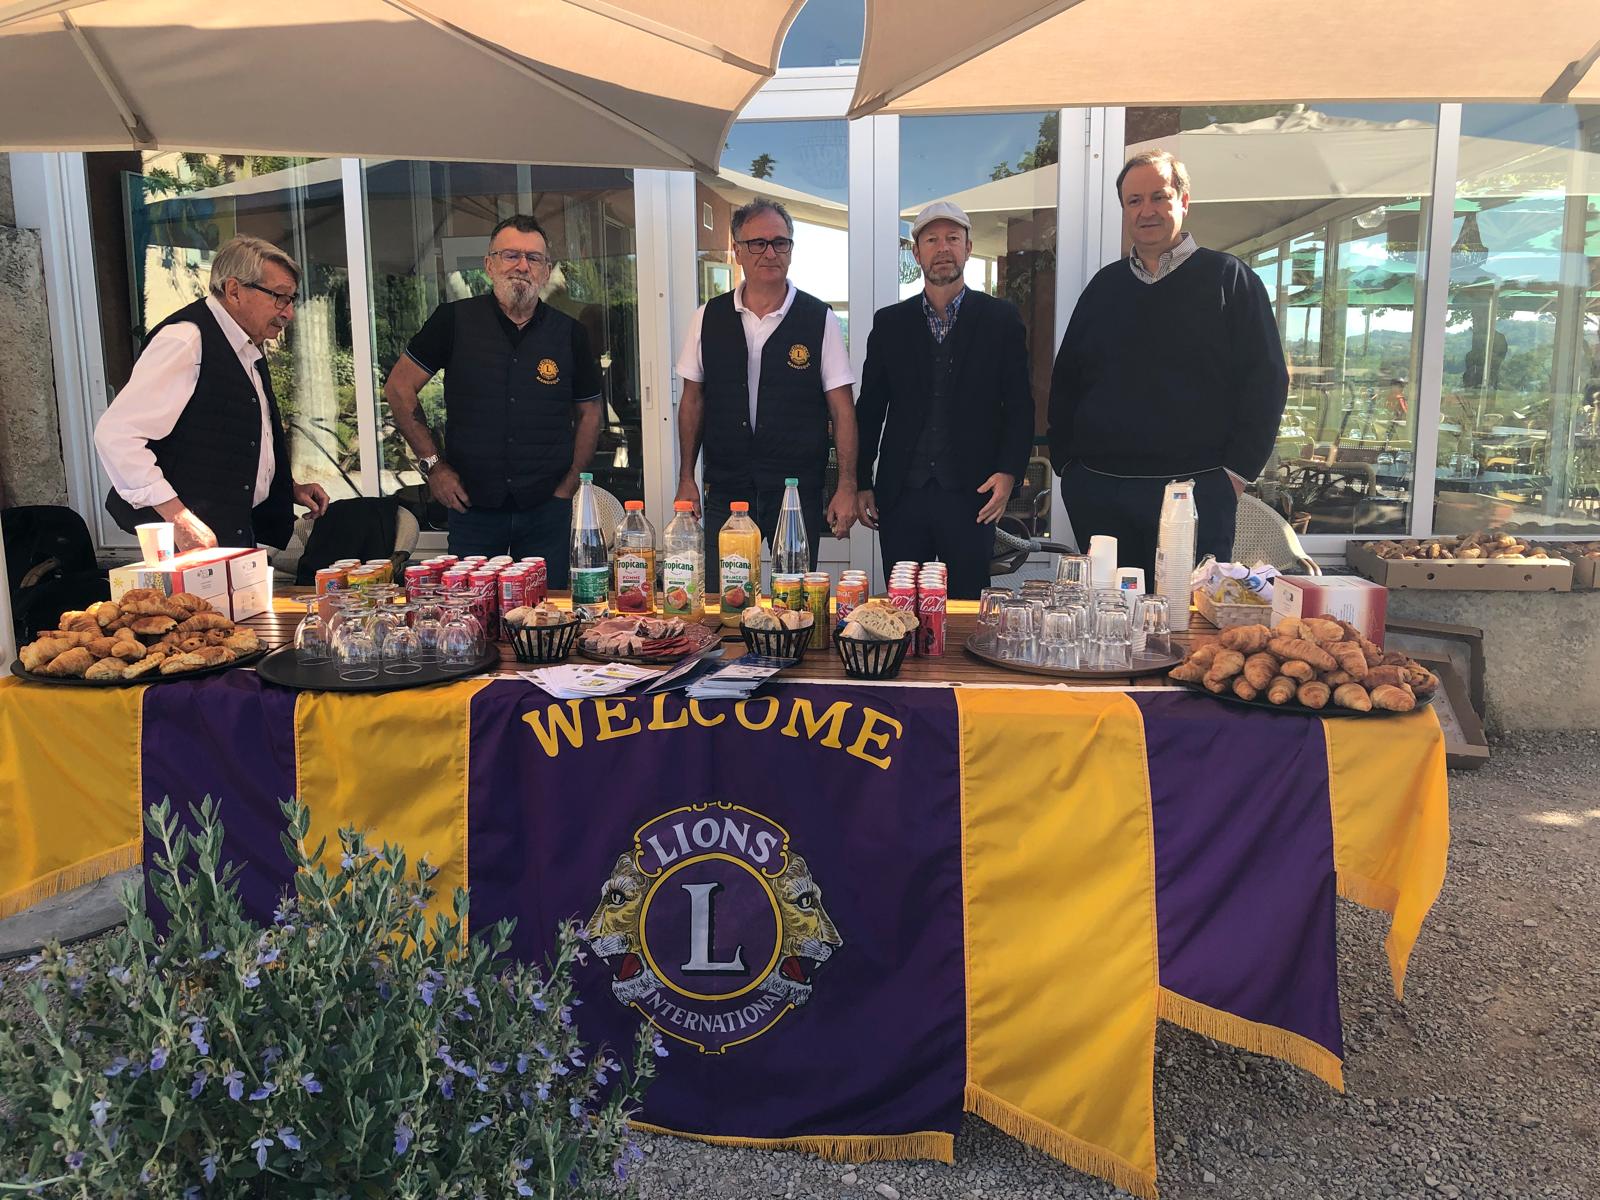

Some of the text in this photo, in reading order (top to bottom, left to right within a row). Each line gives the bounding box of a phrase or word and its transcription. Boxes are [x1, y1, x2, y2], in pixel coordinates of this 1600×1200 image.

[617, 560, 648, 570] Tropicana
[663, 560, 694, 571] Tropicana
[720, 559, 752, 570] Tropicana
[521, 692, 904, 770] WELCOME
[646, 817, 778, 866] LIONS
[680, 882, 746, 972] L
[640, 987, 786, 1033] INTERNATIONAL
